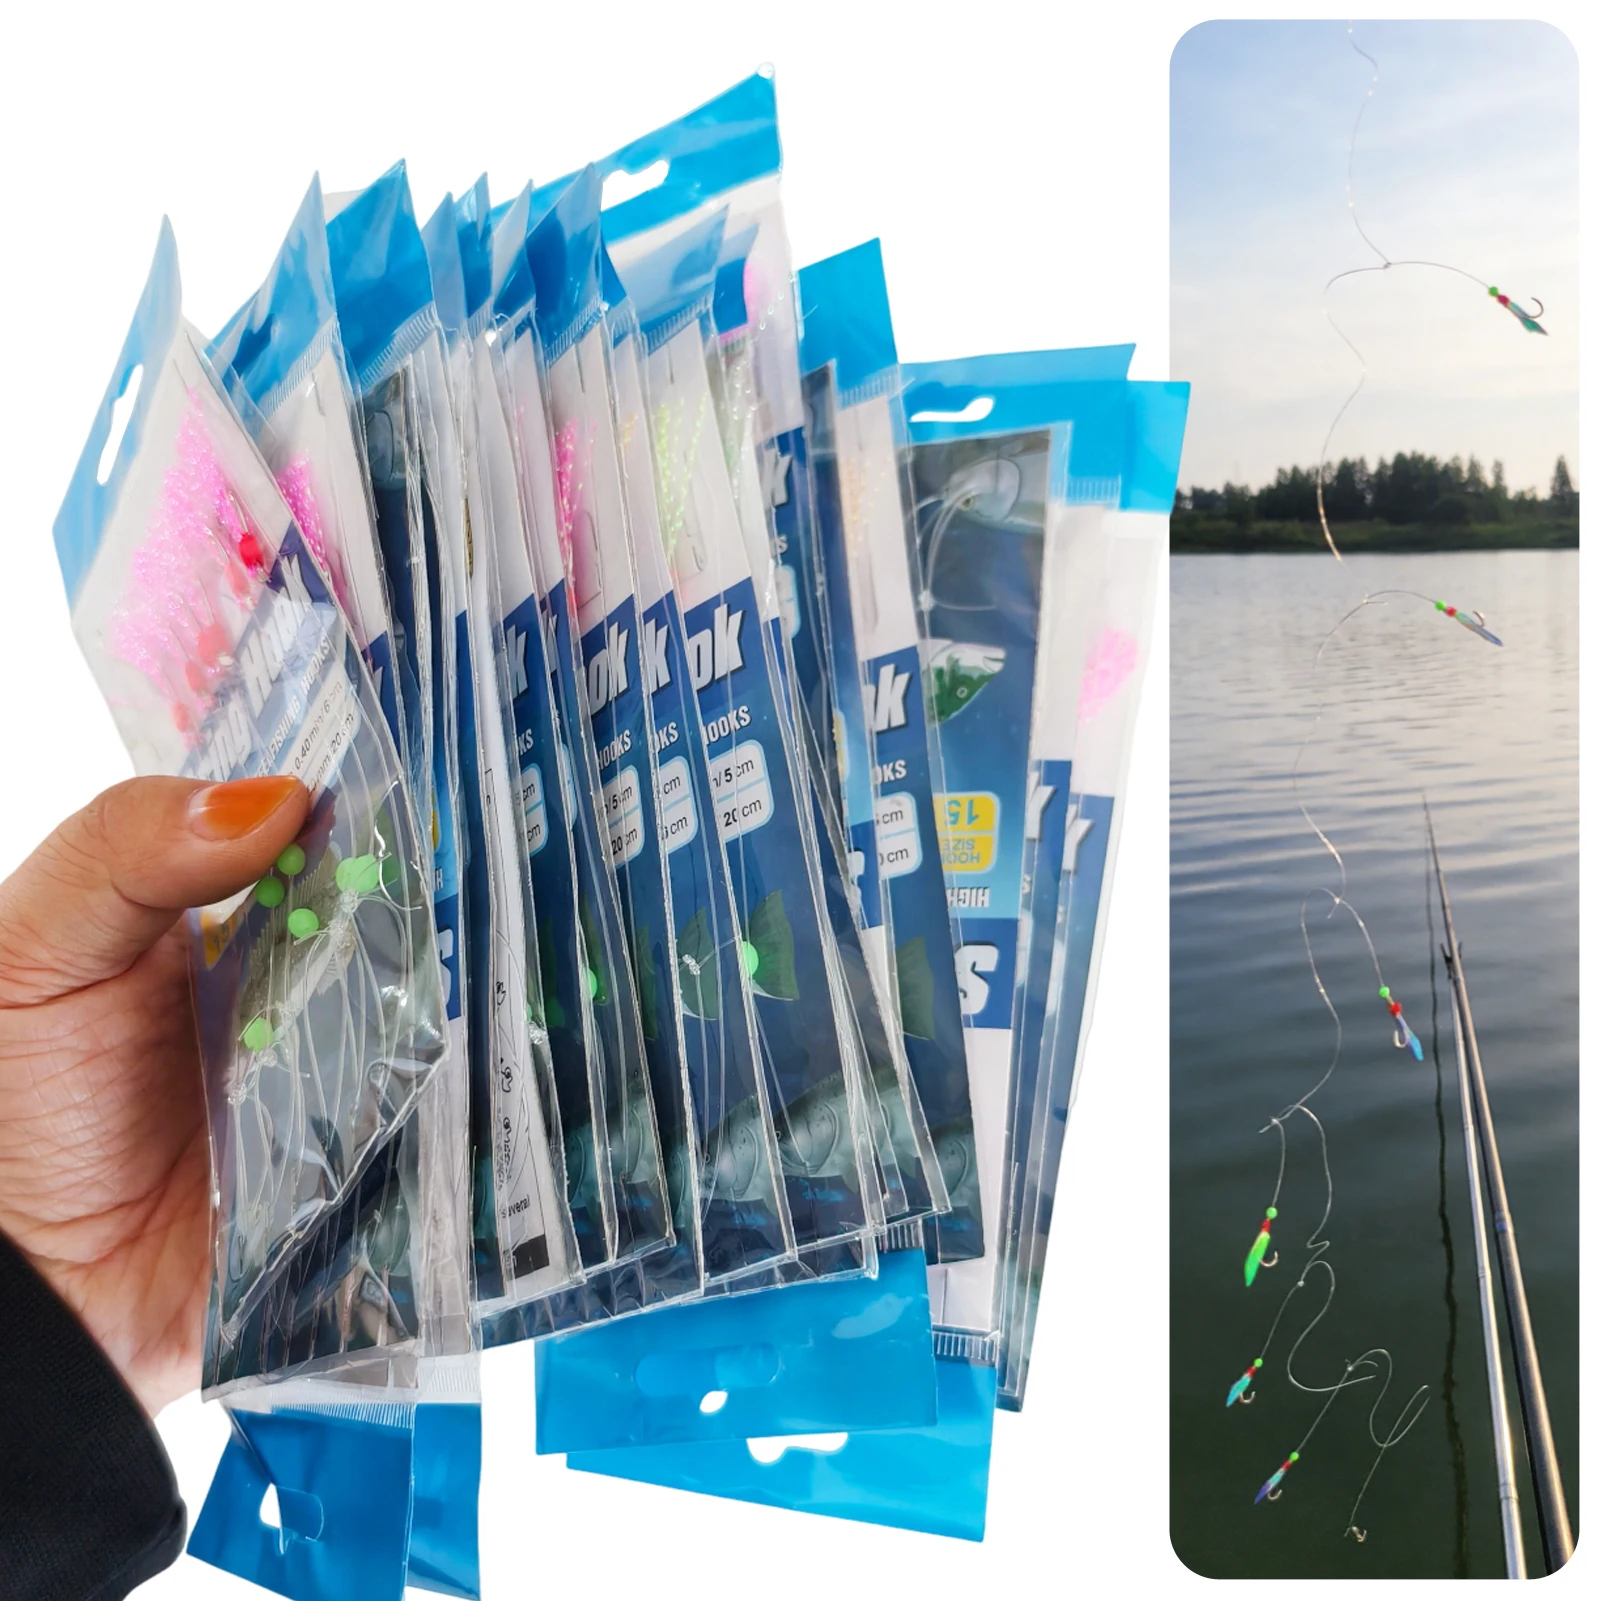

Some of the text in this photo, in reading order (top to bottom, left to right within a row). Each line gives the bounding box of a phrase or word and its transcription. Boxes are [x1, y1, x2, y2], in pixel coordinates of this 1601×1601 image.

[688, 603, 744, 690] ok
[588, 621, 629, 716] ok
[663, 776, 681, 795] cm
[741, 799, 762, 818] cm
[882, 810, 904, 824] cm
[944, 800, 979, 825] 15
[670, 816, 688, 835] cm
[887, 848, 909, 863] cm
